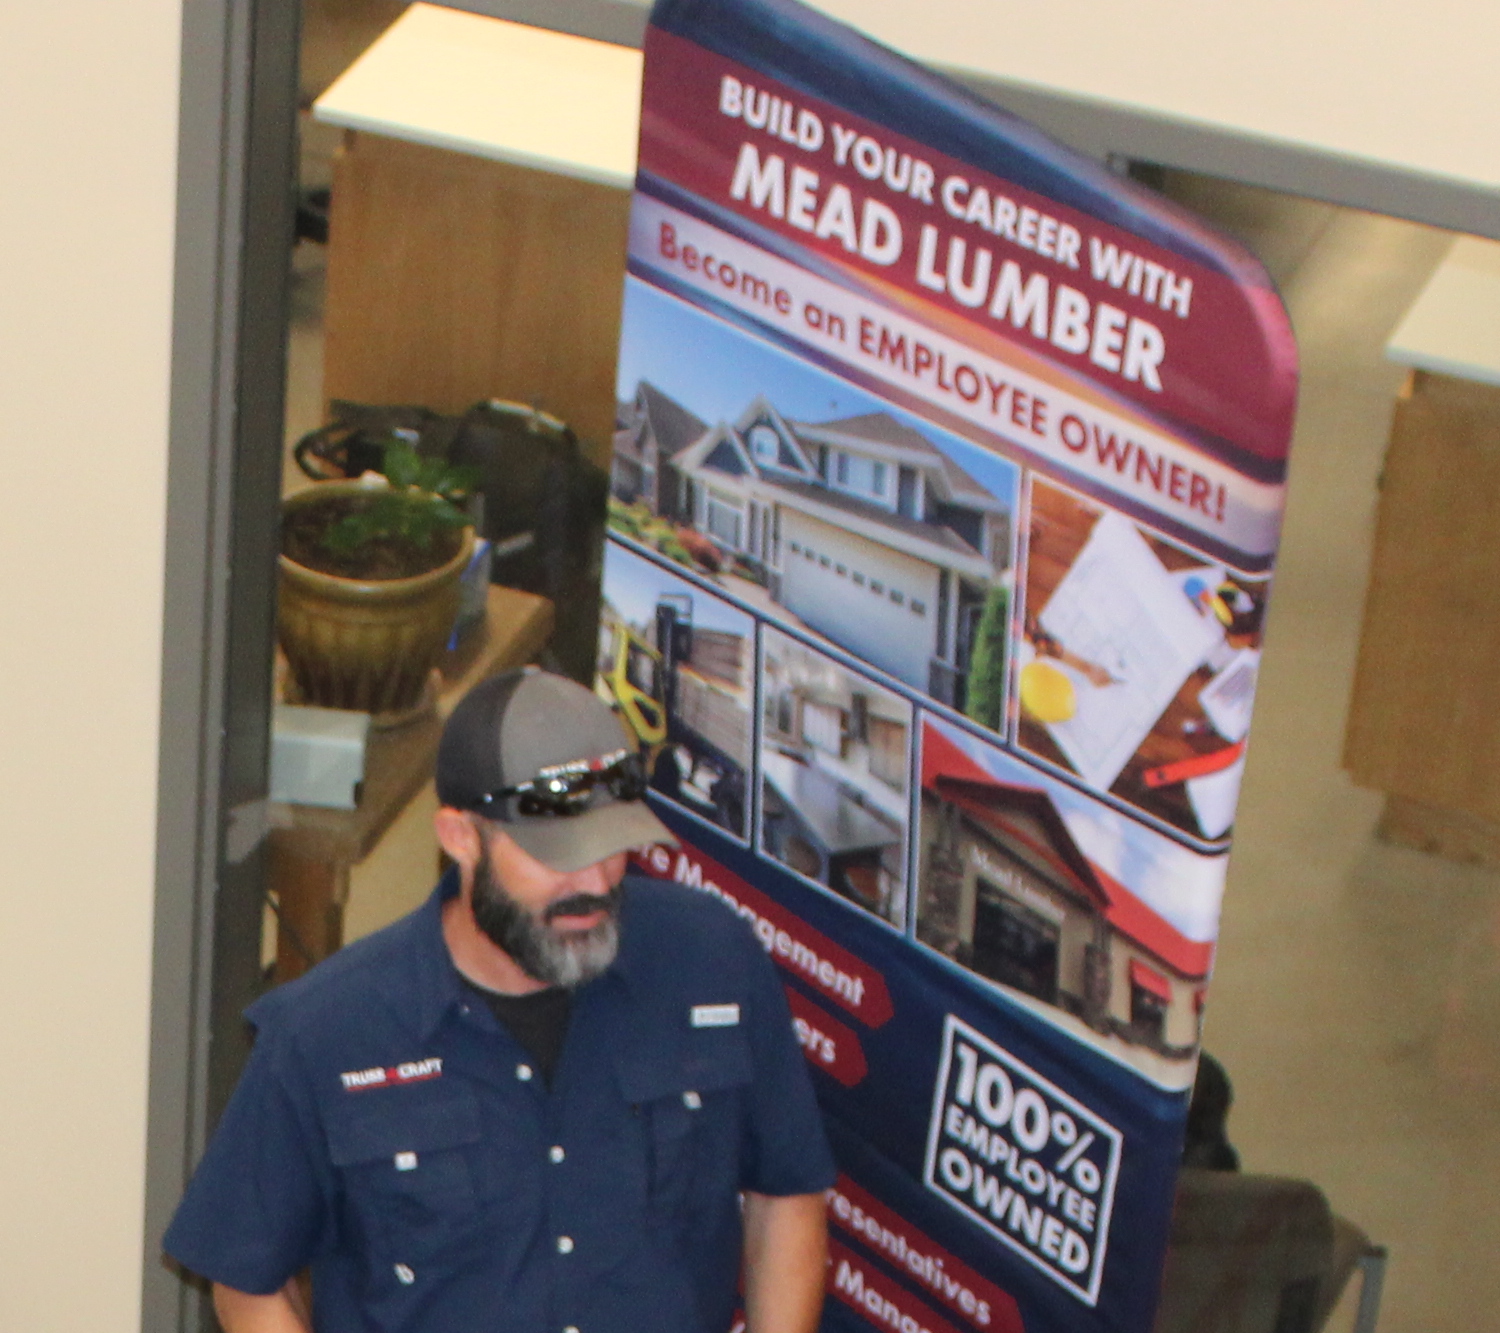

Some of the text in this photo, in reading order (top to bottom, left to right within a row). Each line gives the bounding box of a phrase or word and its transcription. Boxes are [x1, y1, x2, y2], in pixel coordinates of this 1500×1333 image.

[720, 76, 1193, 318] BUILD YOUR CAREER WITH
[730, 143, 1167, 393] MEAD LUMBER
[658, 223, 1228, 523] Become an EMPLOYEE OWNER!
[341, 1058, 443, 1089] TRUSS CRAFT
[953, 1042, 1101, 1194] 100%
[940, 1151, 1090, 1274] OWNED
[945, 1105, 1097, 1233] EMPLOYEE
[825, 1187, 991, 1326] resentatives
